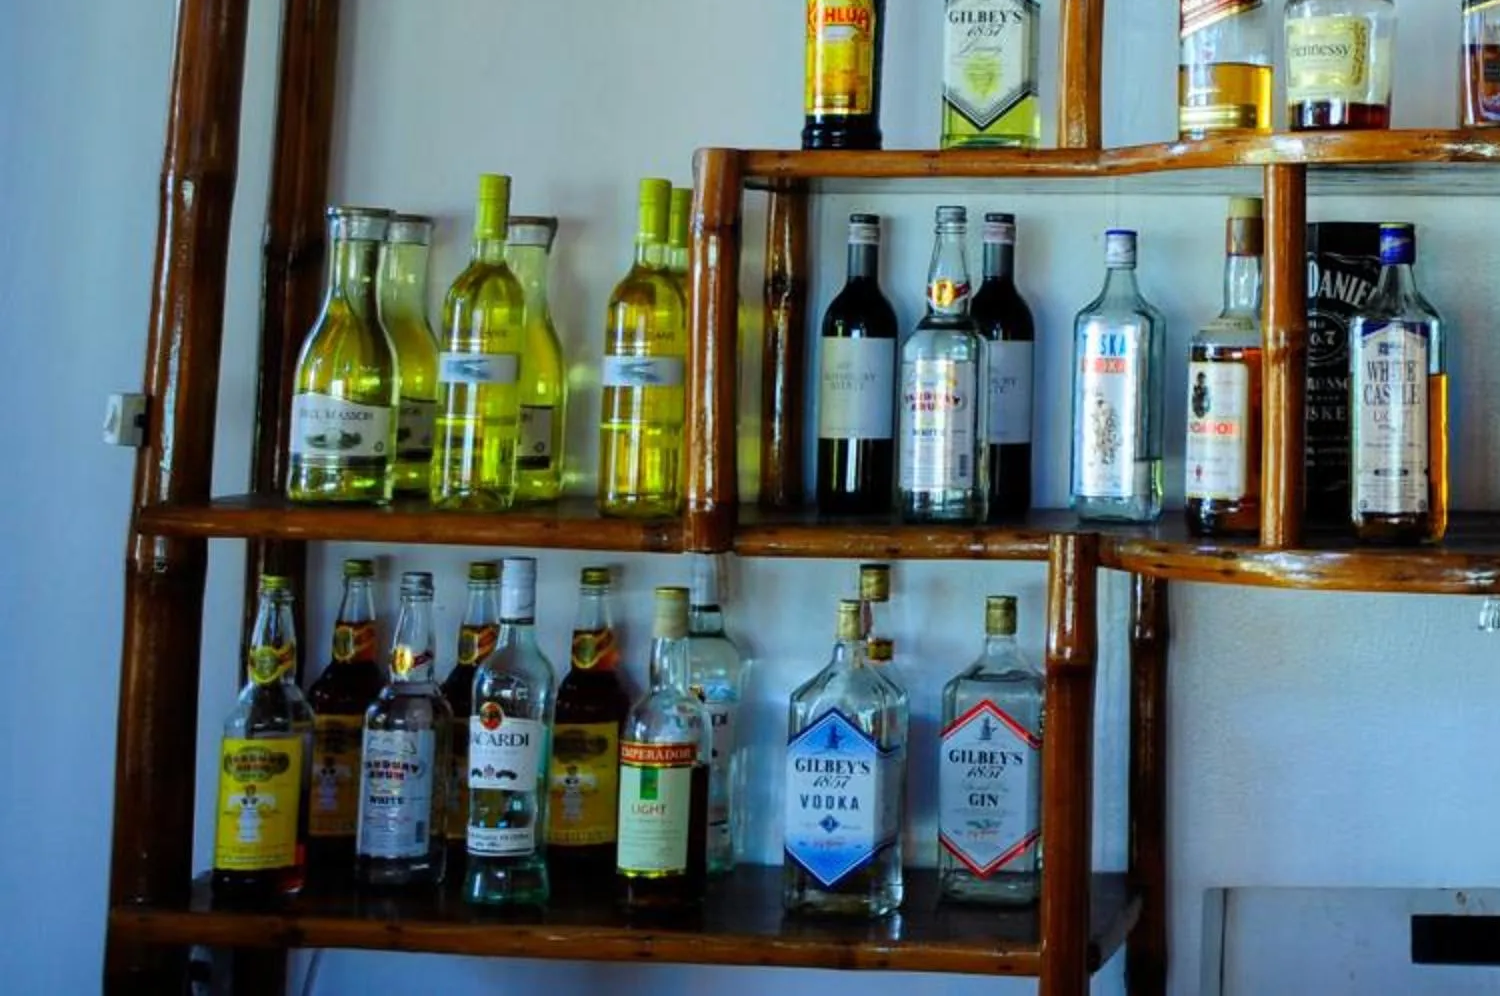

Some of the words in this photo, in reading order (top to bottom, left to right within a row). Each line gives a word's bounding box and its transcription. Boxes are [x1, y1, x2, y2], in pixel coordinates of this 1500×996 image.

[949, 9, 1022, 24] GILBEY'S
[949, 748, 1024, 766] GILBEY'S
[795, 756, 871, 775] GILBEY'S
[800, 794, 861, 812] VODKA
[969, 793, 1000, 807] GIN
[632, 804, 667, 816] LIGHT
